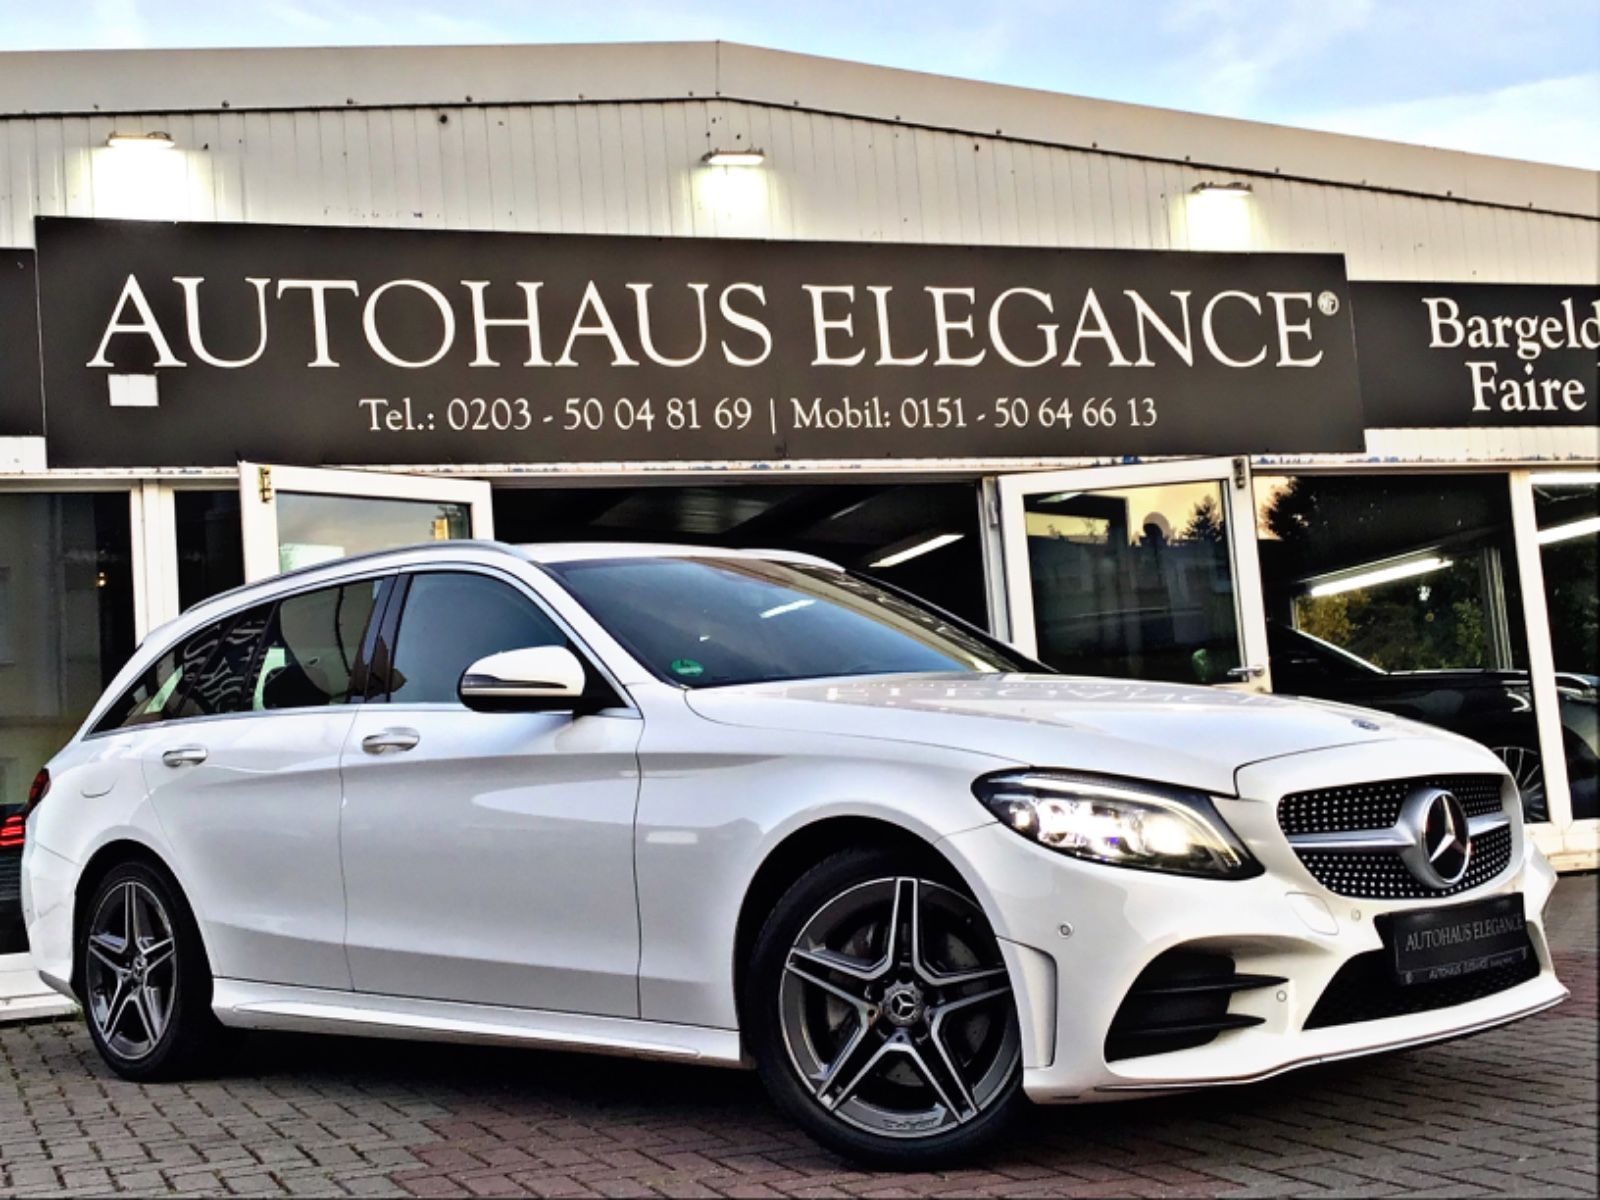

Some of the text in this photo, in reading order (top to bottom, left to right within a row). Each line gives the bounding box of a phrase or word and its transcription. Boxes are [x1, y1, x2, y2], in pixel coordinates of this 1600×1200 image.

[87, 273, 772, 368] AUTOHAUS
[1421, 297, 1600, 360] Bargeld
[1464, 361, 1588, 412] Faire
[359, 397, 435, 430] Tel.:
[446, 397, 532, 431] 0203
[563, 397, 604, 431] 50
[614, 397, 656, 432] 04
[666, 397, 702, 430] 81
[714, 397, 753, 430] 69
[789, 396, 891, 429] Mobil:
[899, 397, 968, 429] 0151
[994, 397, 1030, 428] 50
[1037, 397, 1074, 430] 64
[1081, 397, 1117, 428] 66
[1127, 397, 1158, 427] 13
[1406, 912, 1523, 951] AUTOHAUS ELEGANCE
